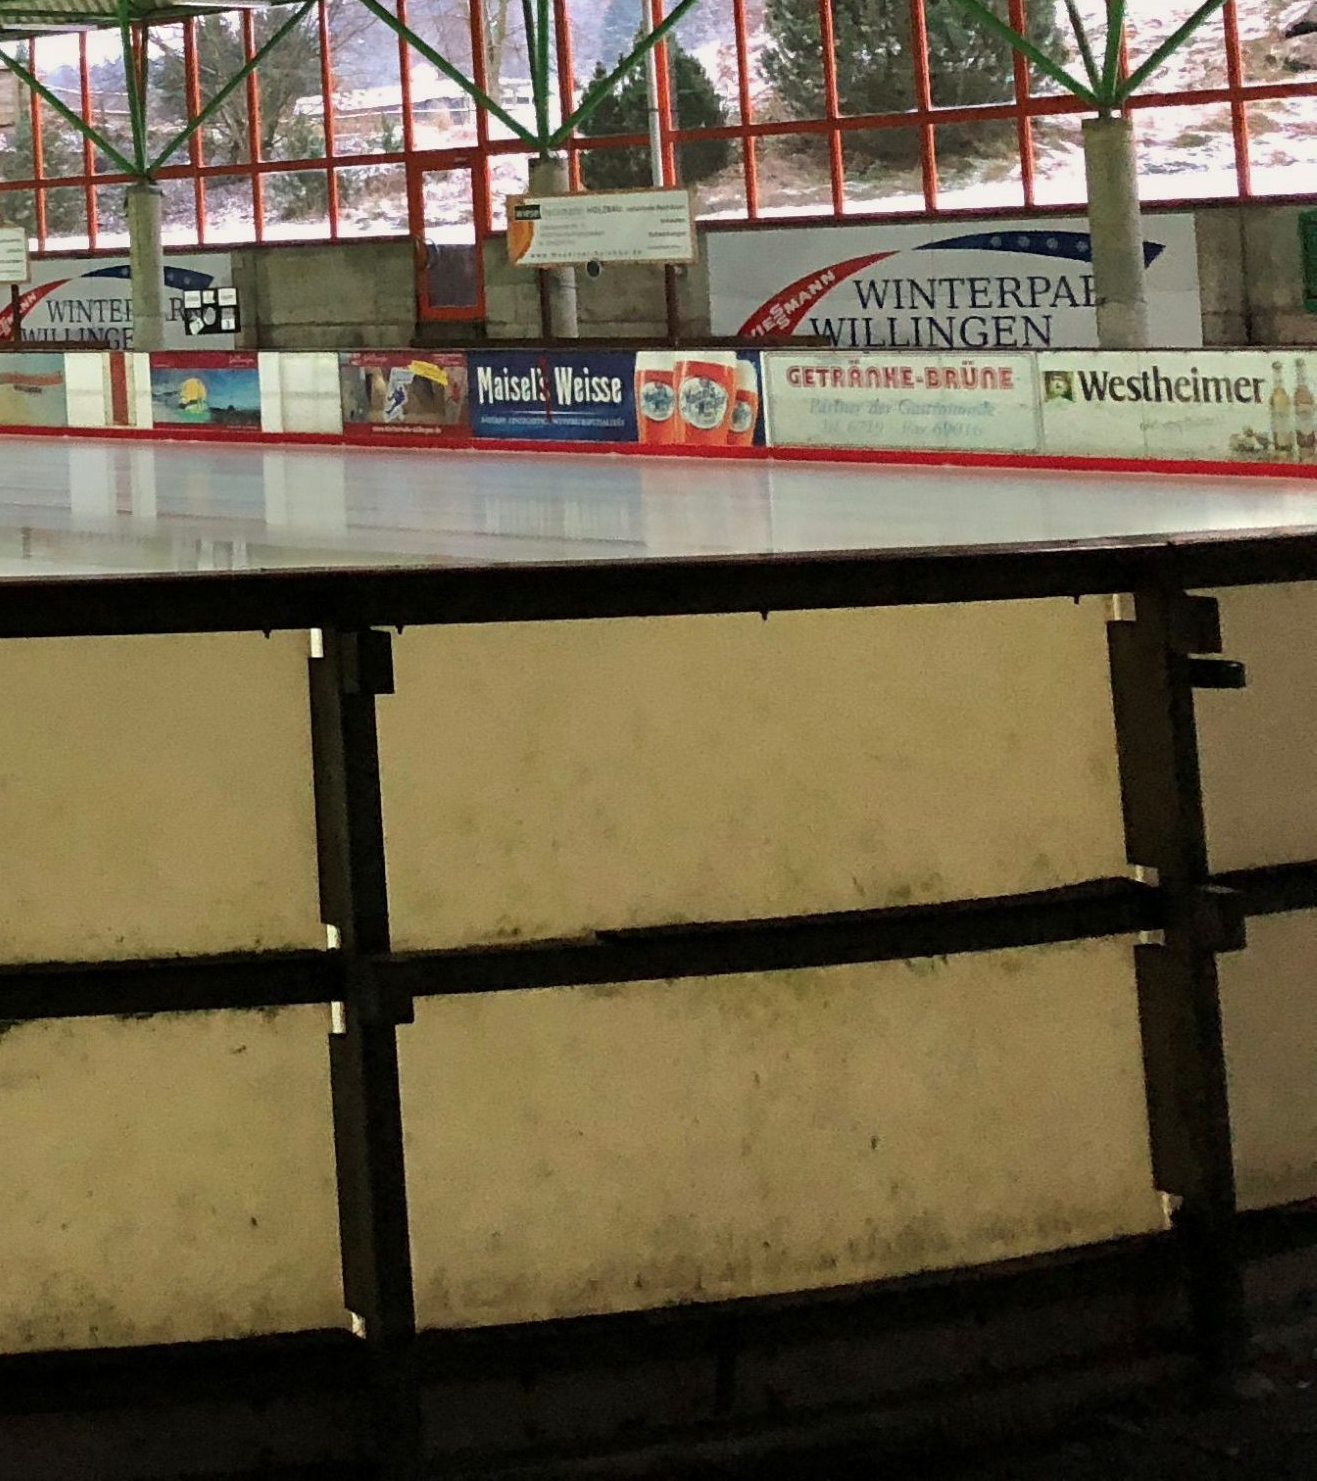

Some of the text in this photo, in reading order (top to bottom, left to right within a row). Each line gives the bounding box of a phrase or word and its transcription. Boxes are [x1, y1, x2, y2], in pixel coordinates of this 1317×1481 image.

[853, 275, 1094, 308] WINTERPA
[21, 327, 134, 350] WILLINGE
[810, 314, 1053, 347] WILLINGEN
[477, 366, 549, 404] Maisel's
[554, 366, 623, 405] Weisse
[786, 360, 1014, 389] GETRÄNKE-BRÜNE
[1077, 366, 1266, 403] Westheimer
